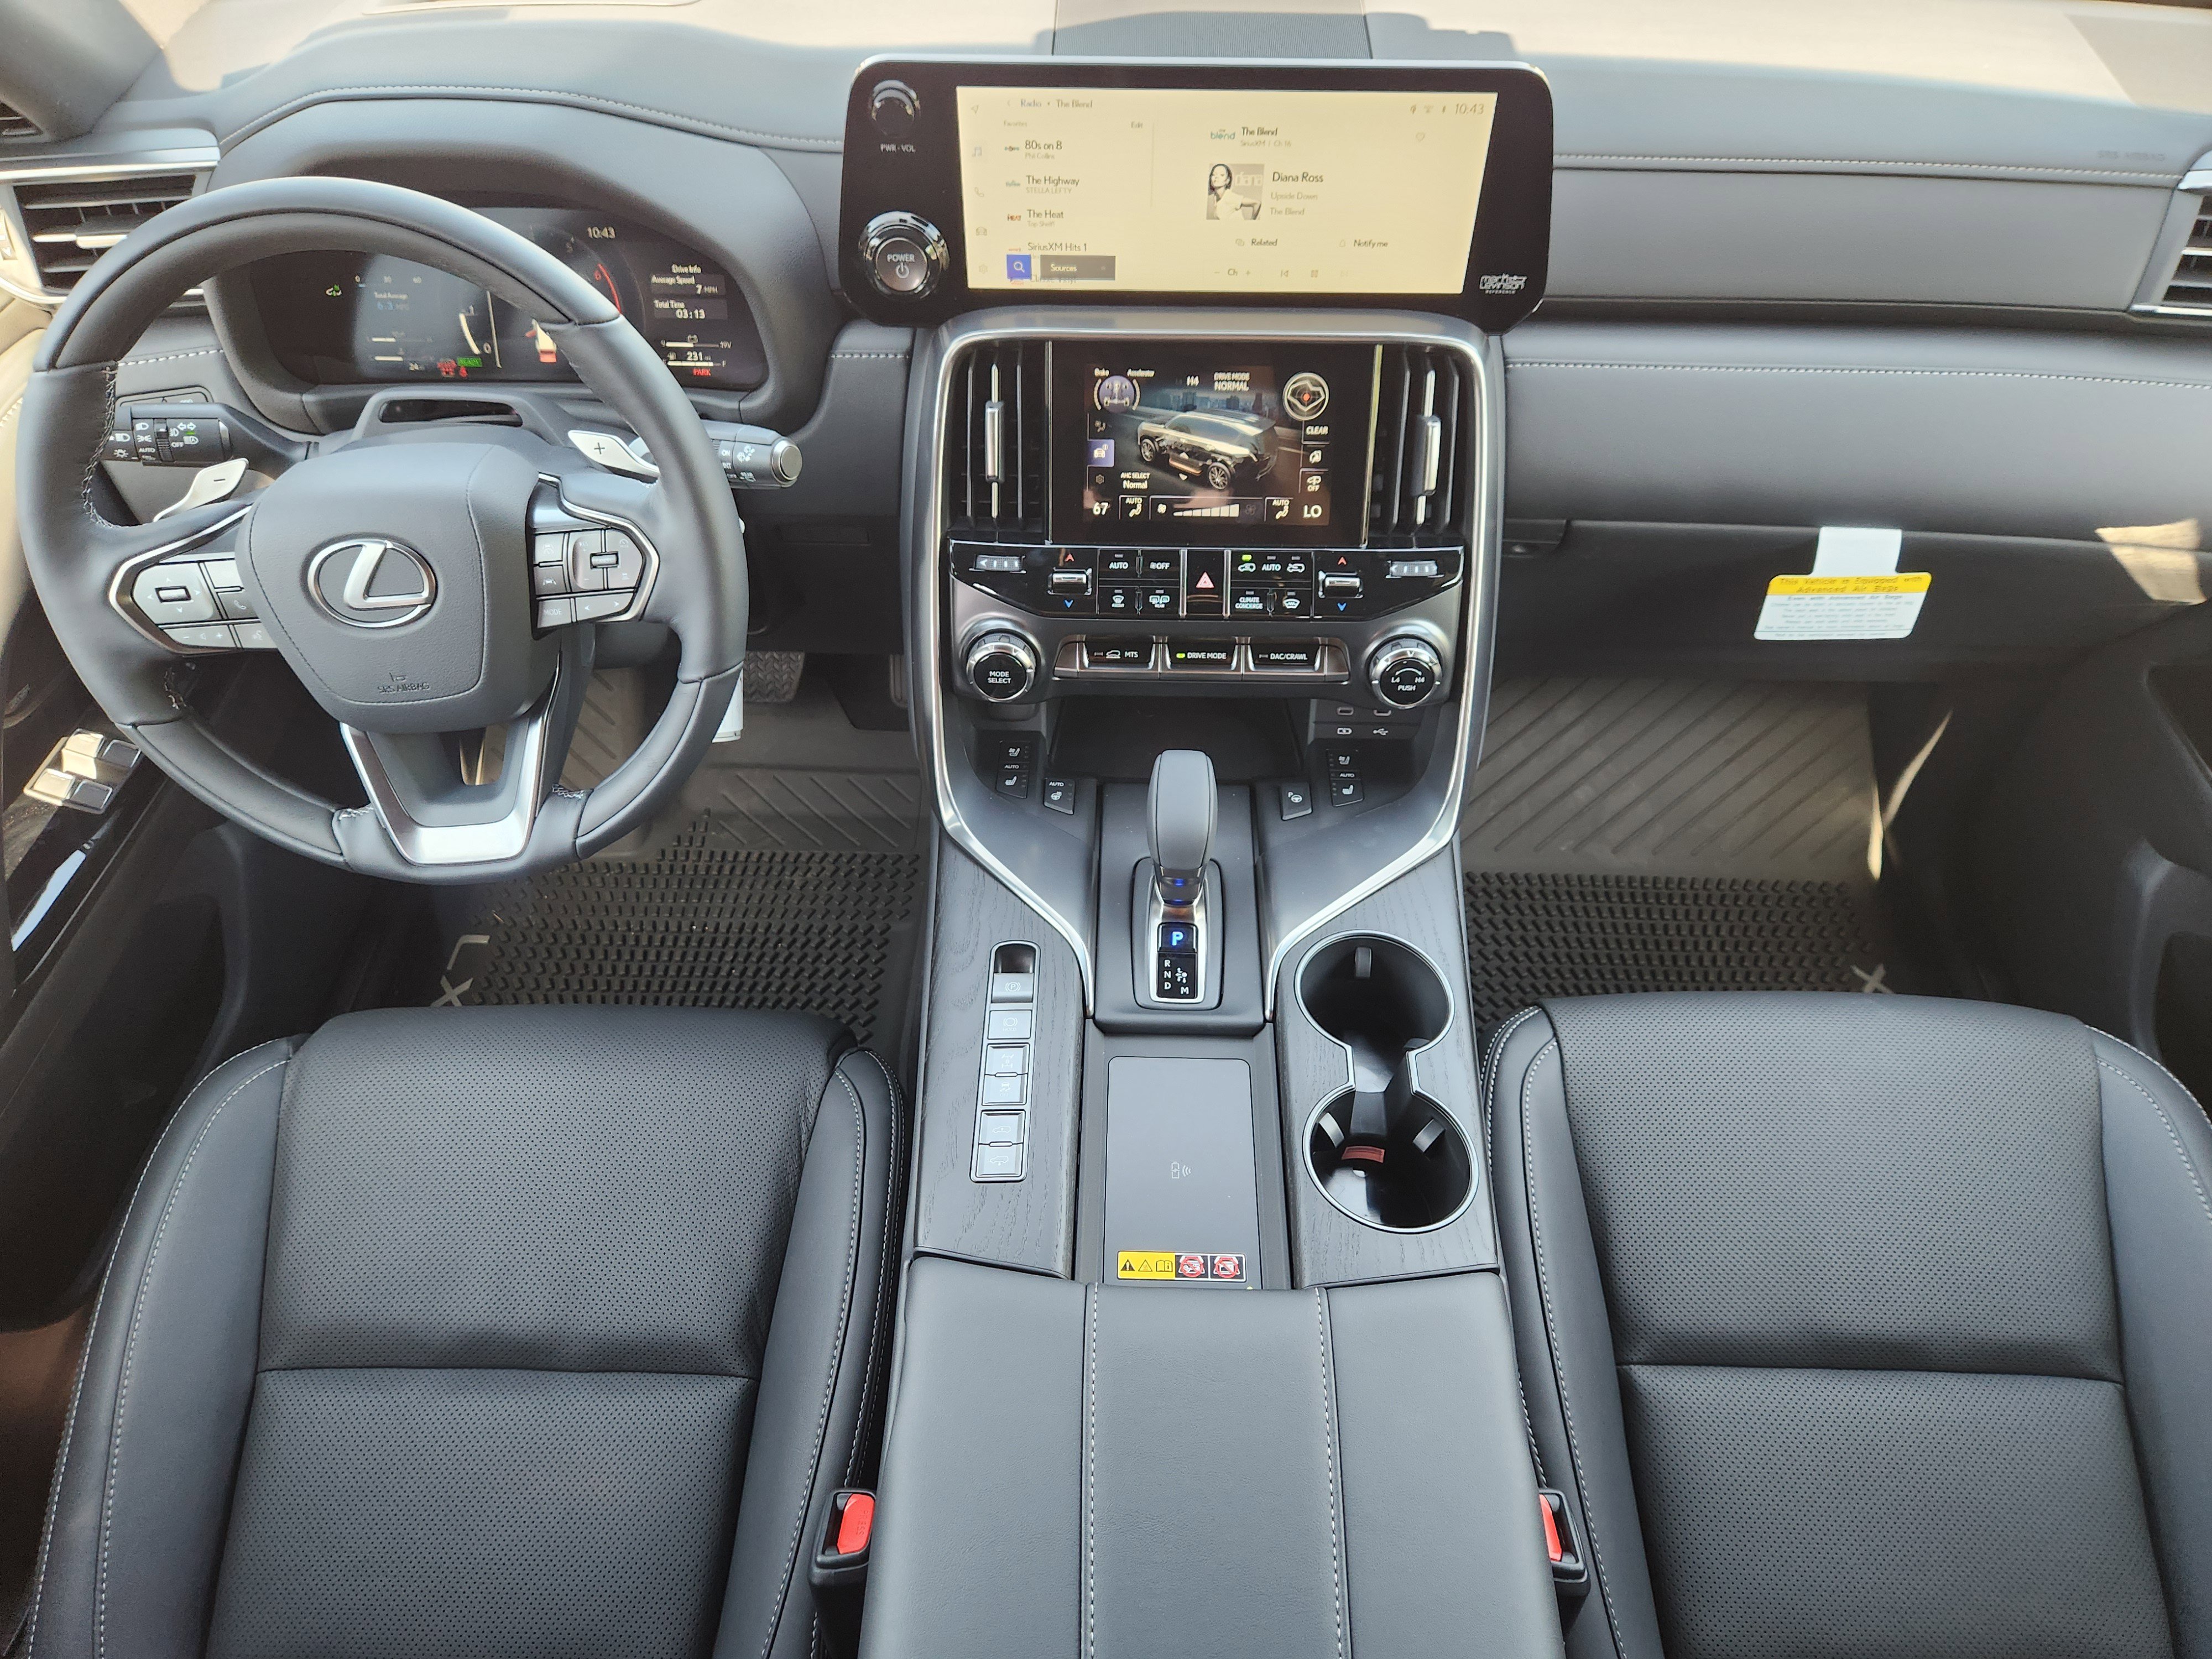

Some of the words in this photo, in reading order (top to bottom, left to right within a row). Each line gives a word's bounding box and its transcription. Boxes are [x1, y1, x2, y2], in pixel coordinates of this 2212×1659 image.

[1056, 99, 1070, 108] The
[1455, 103, 1484, 114] 10:43
[1241, 127, 1255, 135] The
[900, 143, 916, 153] VOL
[1025, 139, 1041, 150] 80s
[1056, 139, 1062, 150] 8
[1026, 175, 1041, 184] The
[1044, 175, 1079, 186] Highway
[1272, 171, 1299, 182] Diana
[1301, 171, 1324, 182] Ross
[1027, 209, 1042, 218] The
[1045, 210, 1064, 218] Heat
[587, 226, 615, 239] 10:43
[1027, 242, 1063, 251] SiriusXM
[1065, 242, 1081, 252] Hits
[1084, 243, 1087, 252] 1
[1354, 239, 1376, 249] Notify
[886, 253, 915, 262] POWER
[671, 264, 688, 273] Drive
[688, 264, 701, 273] Info
[651, 275, 676, 285] Average
[696, 284, 702, 294] 7
[654, 300, 669, 308] Total
[686, 351, 702, 361] 231
[1187, 375, 1199, 387] H4
[1214, 372, 1232, 381] DRIVE
[1232, 372, 1250, 382] MODE
[1214, 381, 1249, 392] NORMAL
[1306, 426, 1329, 435] CLEAR
[1123, 480, 1148, 489] Normal
[1092, 502, 1109, 515] 67
[1303, 505, 1322, 519] LO
[1171, 931, 1183, 946] P
[1164, 970, 1171, 979] N
[1164, 982, 1172, 990] D
[1180, 986, 1190, 994] M
